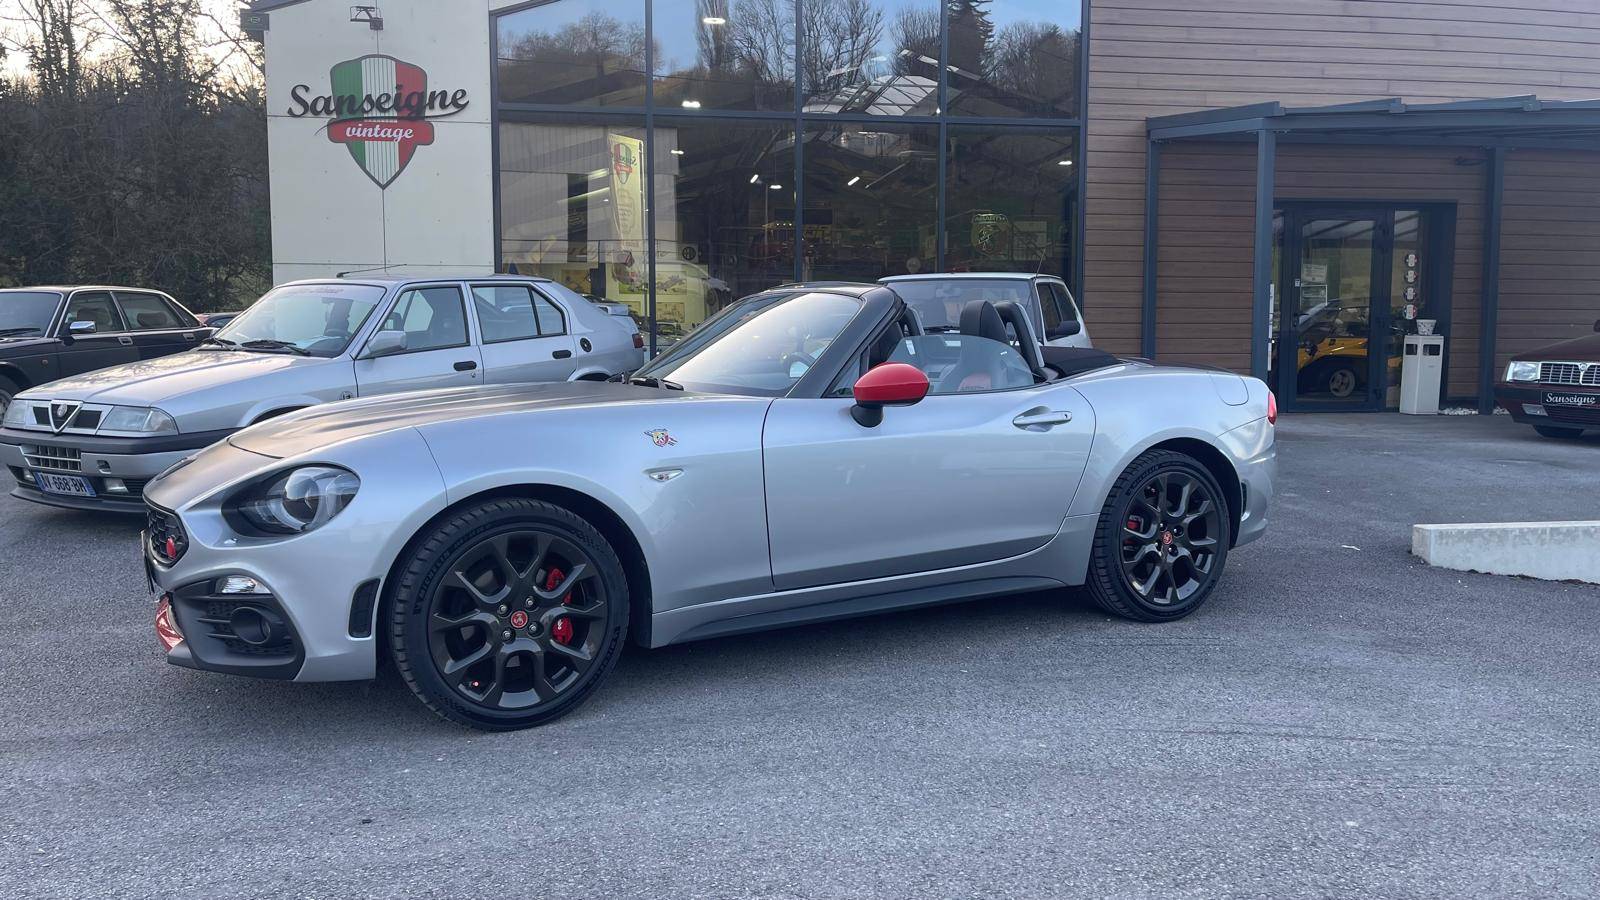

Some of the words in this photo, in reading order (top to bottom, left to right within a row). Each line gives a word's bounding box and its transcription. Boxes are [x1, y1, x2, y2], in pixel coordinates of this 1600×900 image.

[287, 84, 470, 119] Sanseigne
[345, 124, 414, 142] vintage
[1546, 392, 1596, 405] Sanseigne
